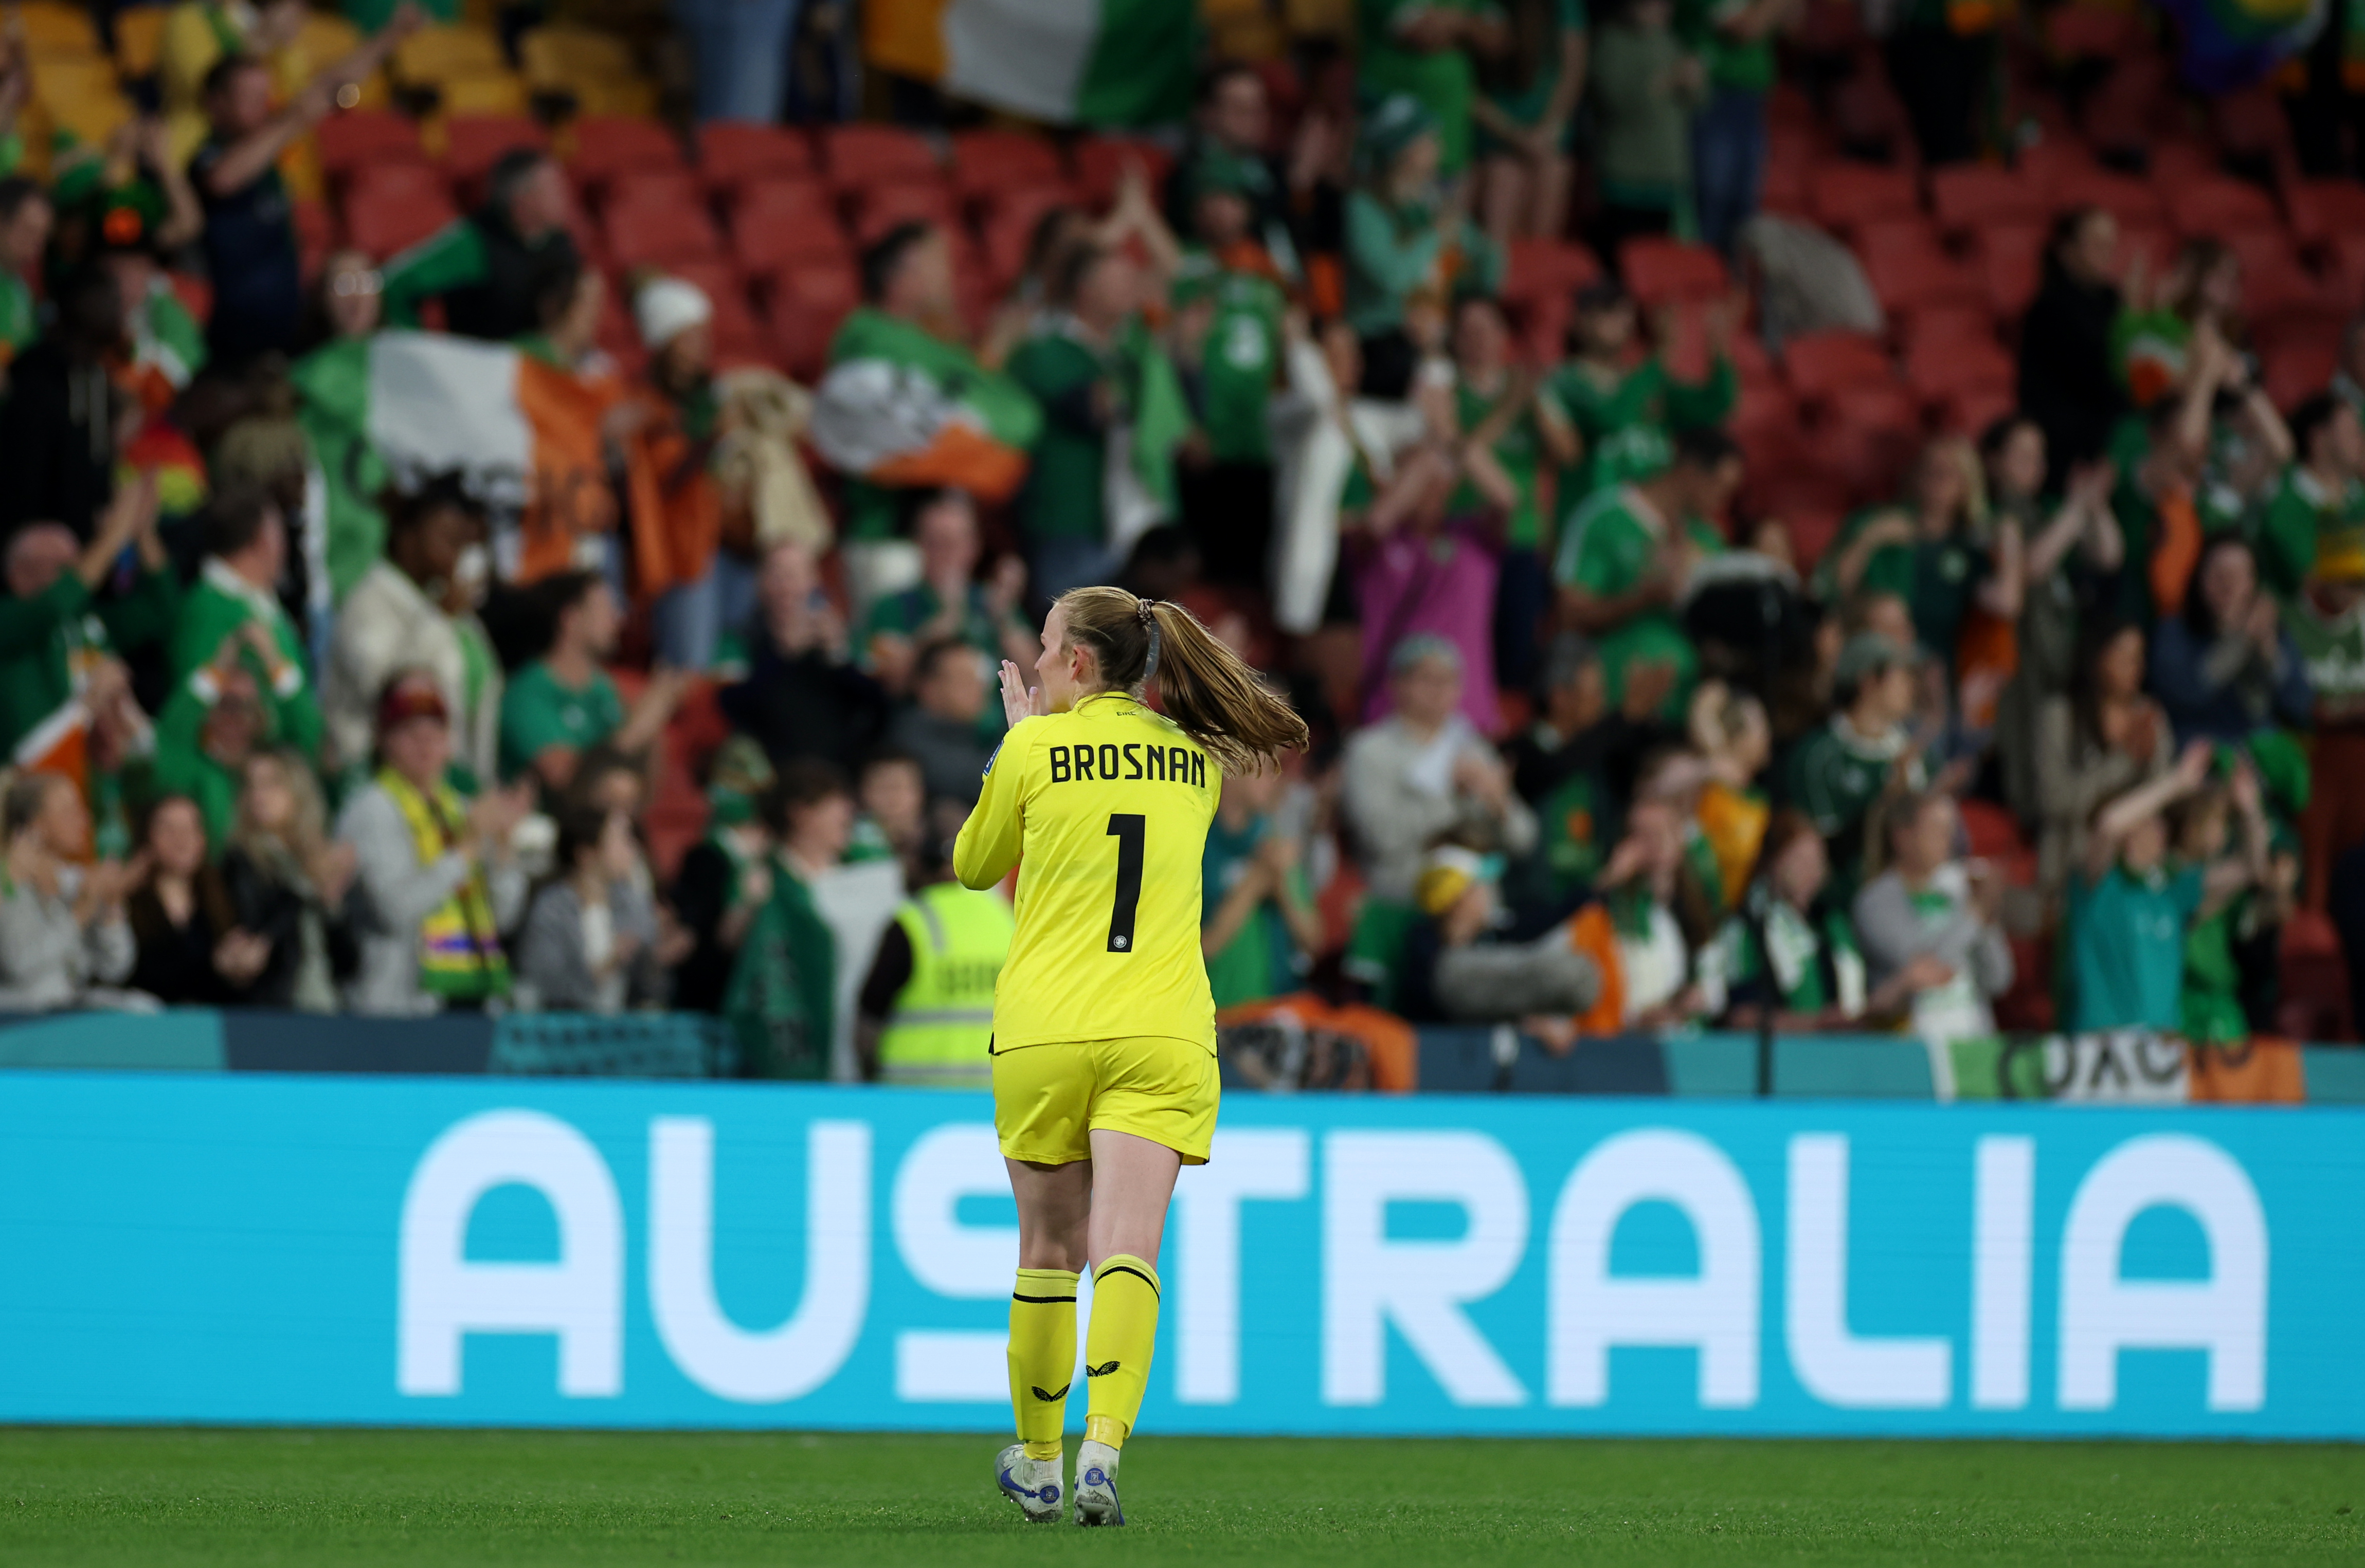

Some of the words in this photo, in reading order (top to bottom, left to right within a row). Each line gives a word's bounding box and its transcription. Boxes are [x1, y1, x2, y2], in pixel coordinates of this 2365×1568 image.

[1050, 743, 1205, 789] BROSNAN
[1106, 813, 1146, 953] 1
[397, 1108, 2269, 1411] AUSTRALIA
